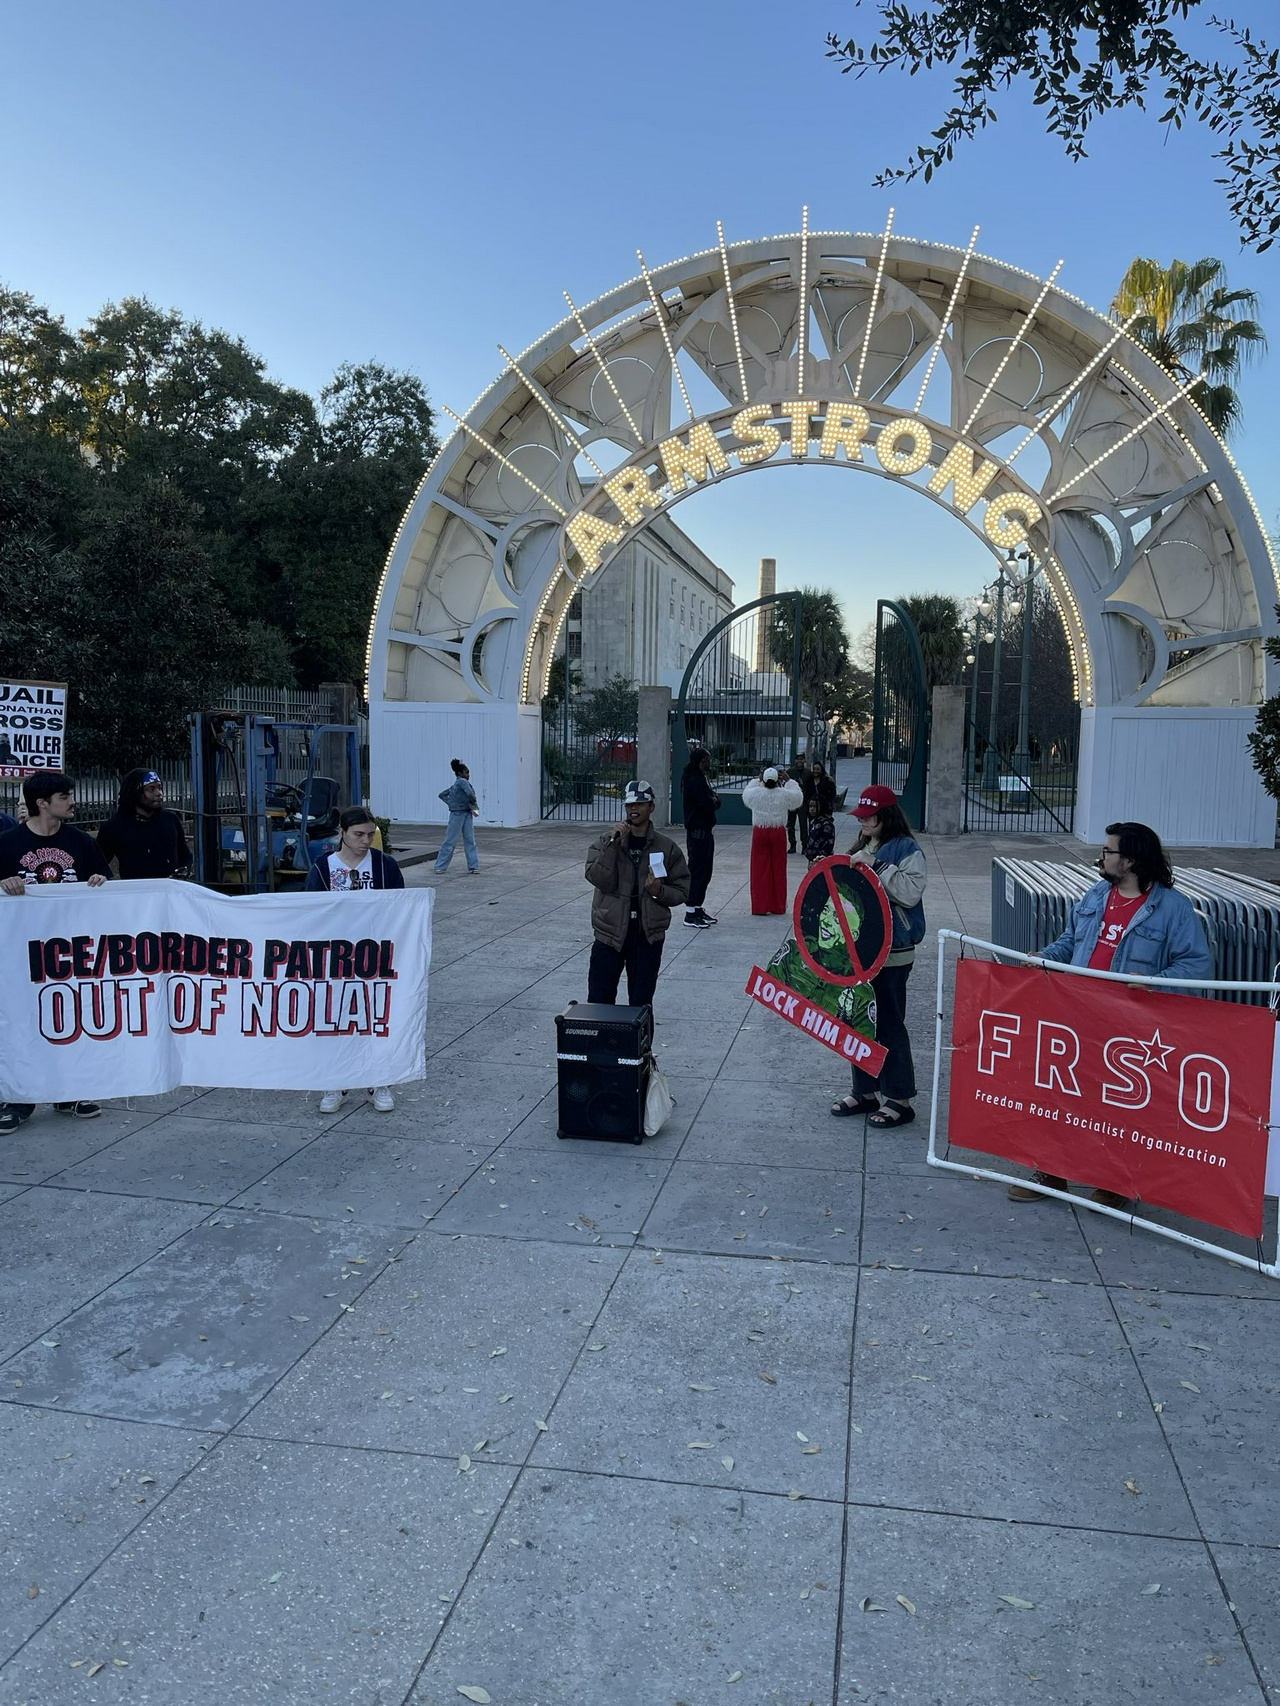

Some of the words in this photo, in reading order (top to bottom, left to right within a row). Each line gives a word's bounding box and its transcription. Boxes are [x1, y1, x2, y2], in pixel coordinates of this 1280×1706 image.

[565, 401, 1043, 574] ARMSTRONG
[0, 686, 64, 706] JAIL
[0, 705, 63, 715] ONATHAN
[13, 734, 61, 754] KILLER
[22, 755, 61, 768] ICE
[29, 932, 253, 982] ICE/BORDER
[263, 939, 398, 979] PATROL
[39, 978, 154, 1044] OUT
[167, 975, 225, 1034] OF
[241, 981, 391, 1037] NOLA!
[752, 975, 799, 1019] LOCK
[800, 1007, 840, 1046] HIM
[843, 1034, 871, 1062] UP
[565, 1028, 598, 1036] SOUNDBOKS
[556, 1052, 587, 1061] SOUNDBOKS
[975, 1089, 1023, 1112] Freedom
[1029, 1103, 1059, 1121] Road
[1065, 1113, 1124, 1139] Socialist
[1131, 1131, 1227, 1168] Organization
